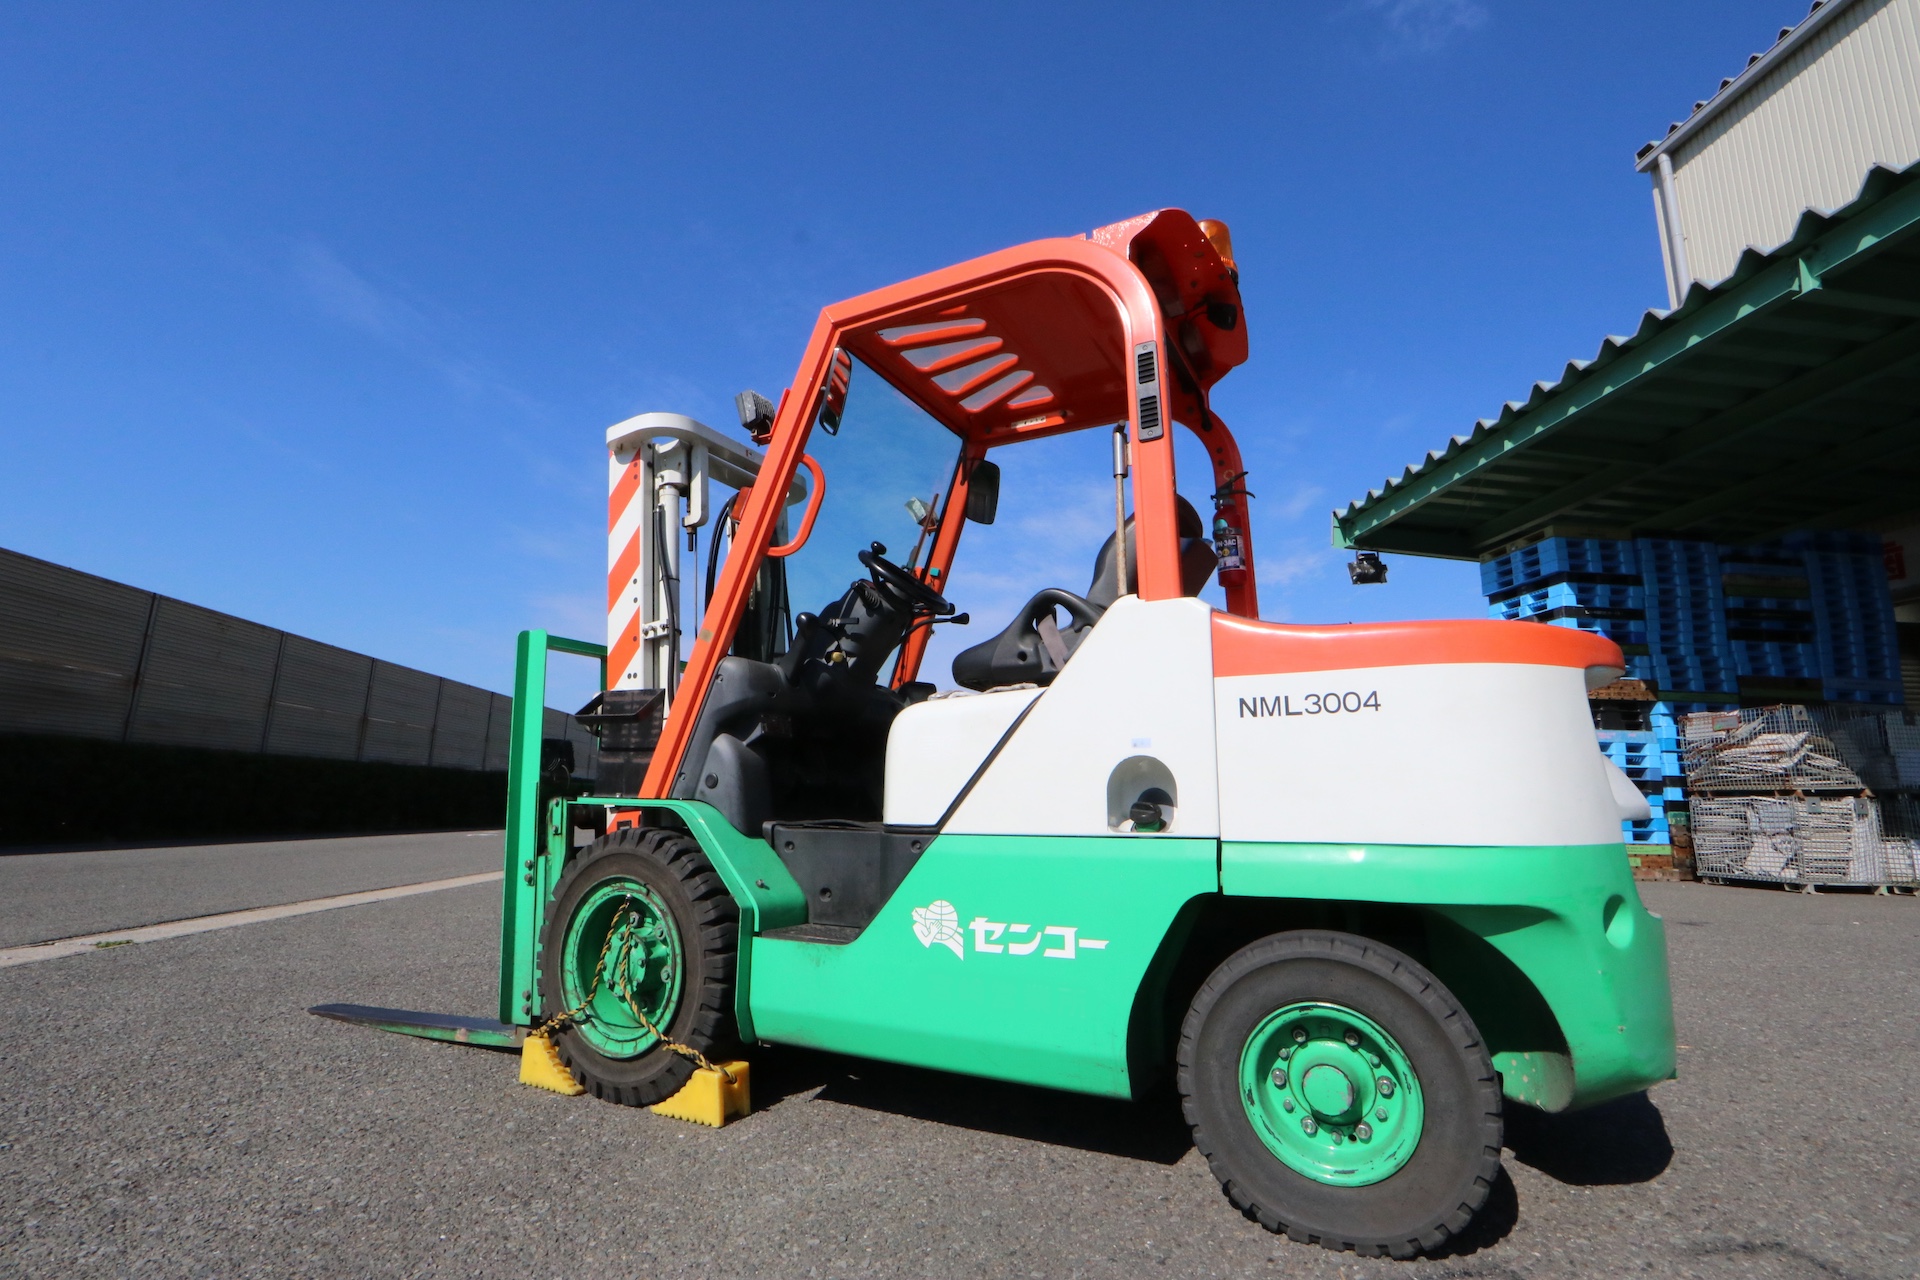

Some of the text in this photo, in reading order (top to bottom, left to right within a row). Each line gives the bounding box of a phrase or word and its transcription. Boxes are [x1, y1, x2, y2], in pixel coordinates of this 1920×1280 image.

[1239, 690, 1381, 718] NML3004
[968, 916, 1110, 959] センコー
